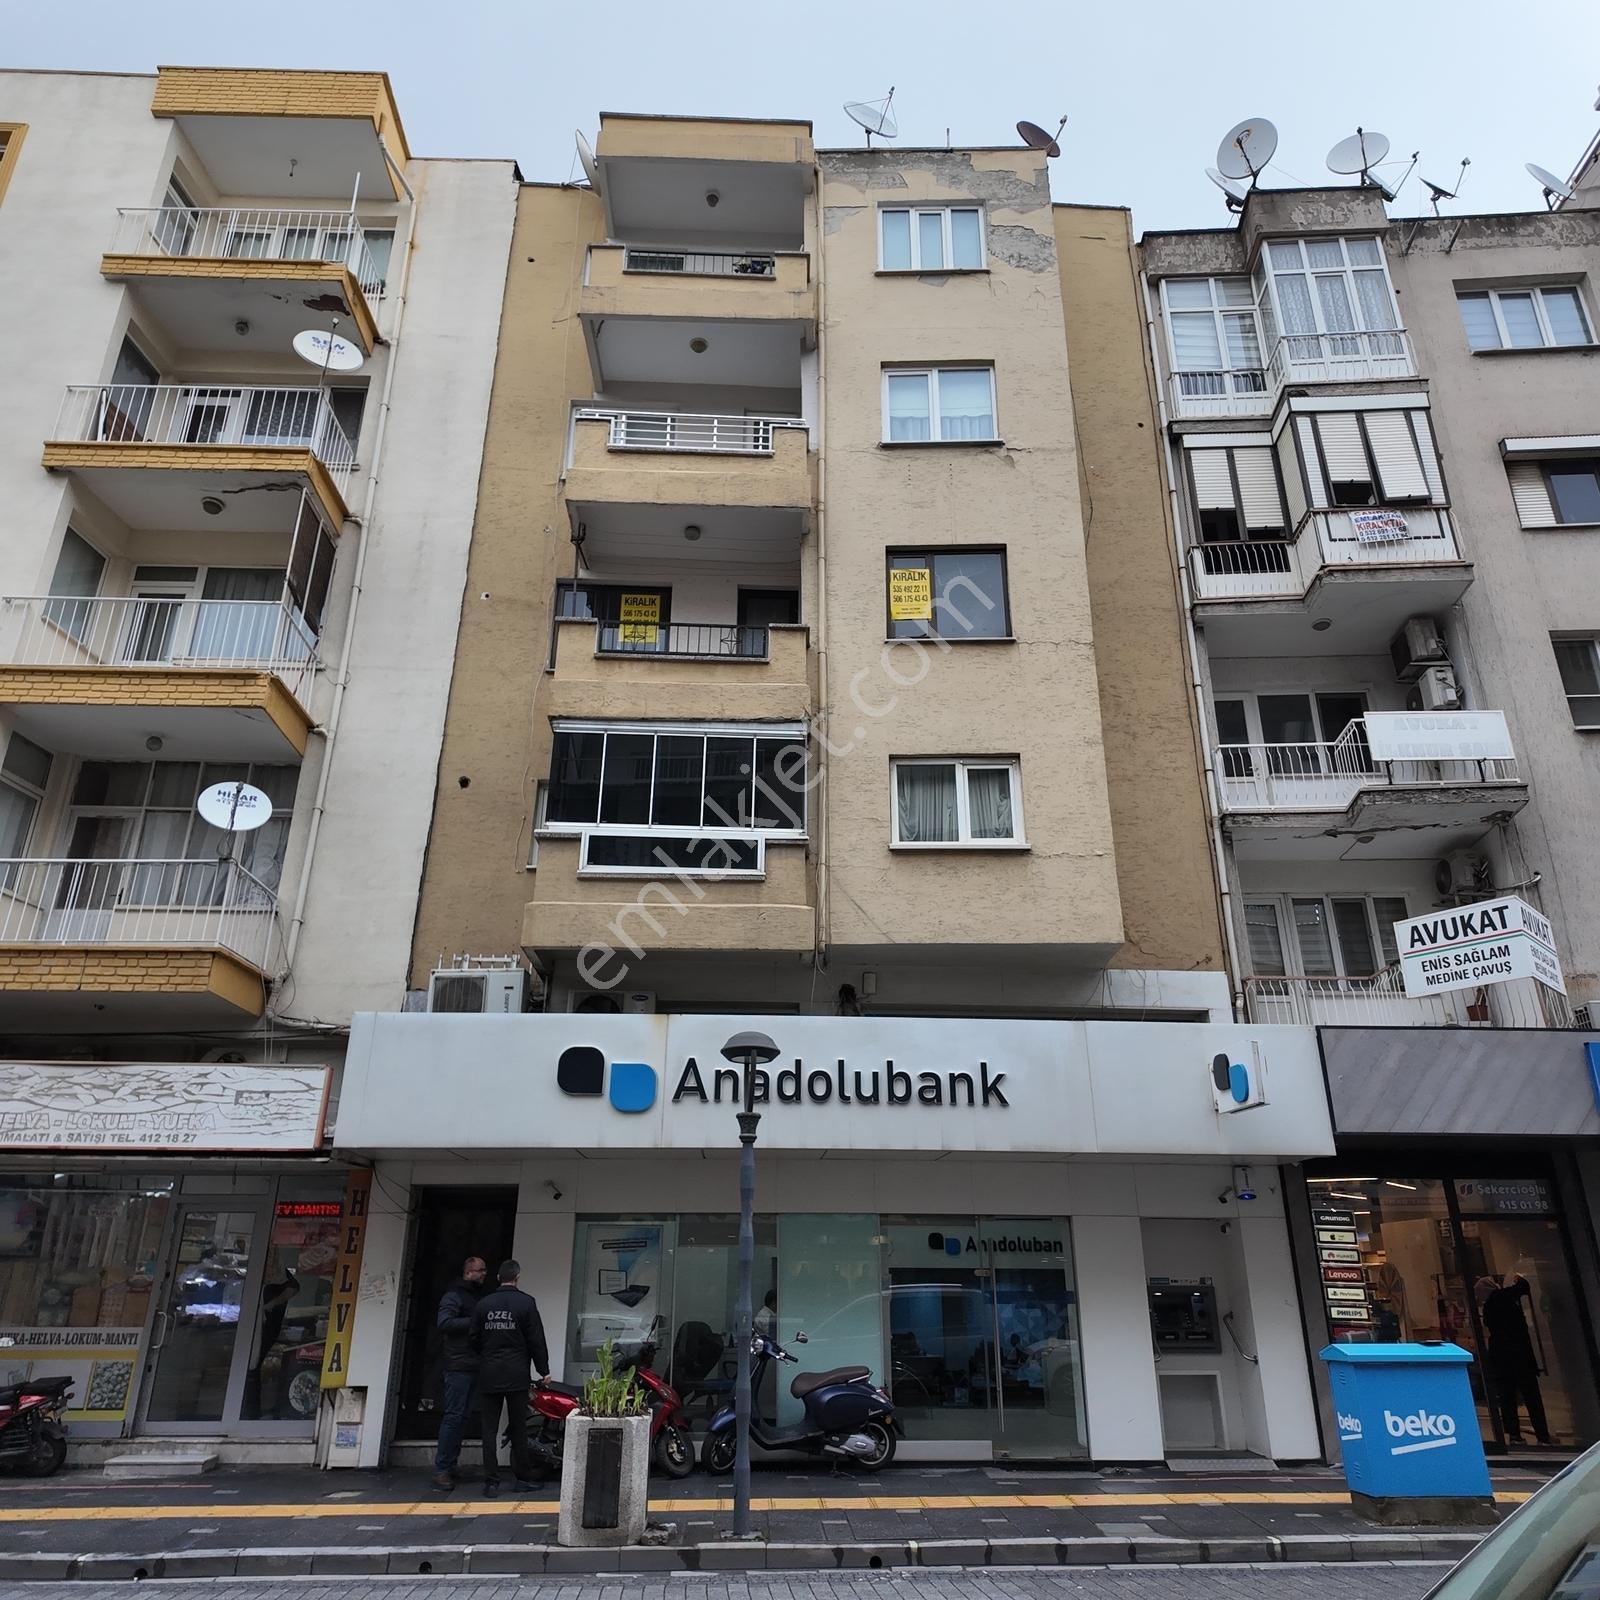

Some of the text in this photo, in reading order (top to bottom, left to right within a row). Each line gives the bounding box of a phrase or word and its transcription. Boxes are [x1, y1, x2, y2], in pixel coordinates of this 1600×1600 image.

[1410, 905, 1509, 948] AVUKAT
[1421, 945, 1511, 972] ENİS SAĞLAM
[1425, 961, 1512, 986] MEDİNE ÇAVUŞ
[672, 1056, 1010, 1106] Anadolubank
[0, 1113, 50, 1130] ELVA
[64, 1113, 136, 1130] LOKUM
[151, 1113, 216, 1131] YUFKA
[110, 1133, 135, 1143] TEL.
[139, 1133, 161, 1143] 412
[165, 1134, 179, 1144] 18
[181, 1134, 198, 1144] 27
[328, 1189, 368, 1372] HELVA
[1328, 1270, 1358, 1279] Lenovo
[1337, 1412, 1362, 1432] beko
[1384, 1409, 1456, 1437] beko
